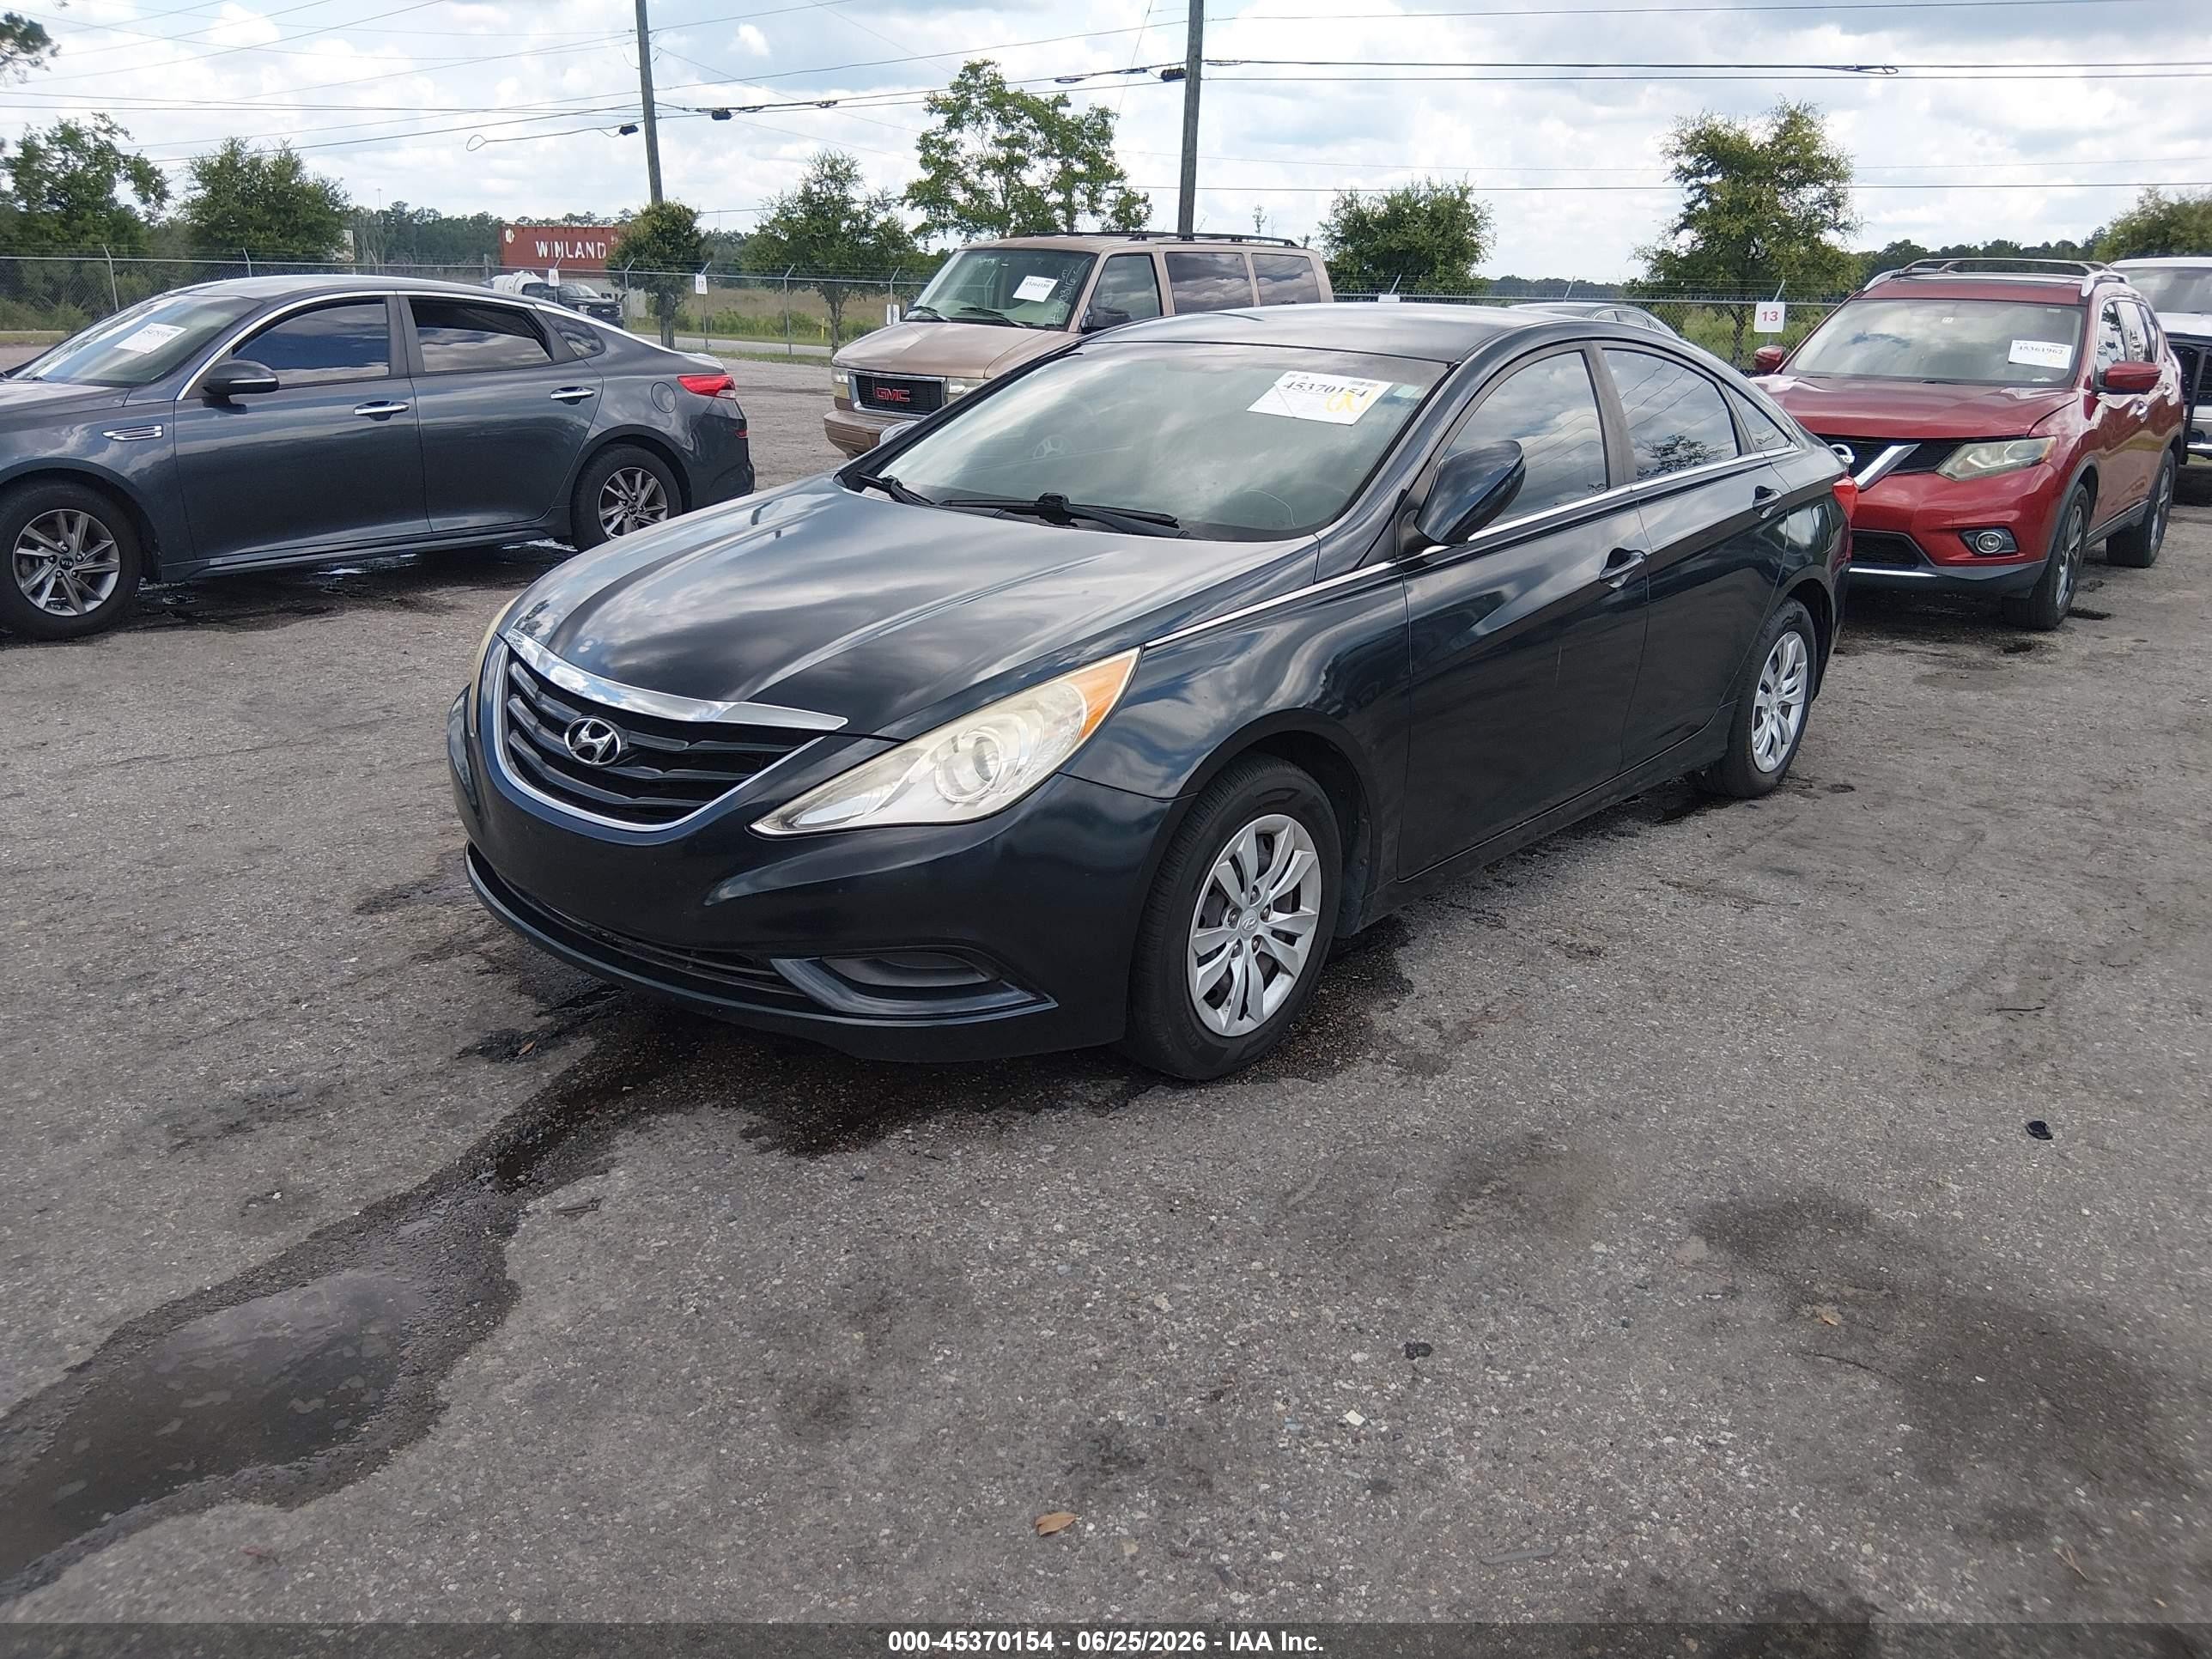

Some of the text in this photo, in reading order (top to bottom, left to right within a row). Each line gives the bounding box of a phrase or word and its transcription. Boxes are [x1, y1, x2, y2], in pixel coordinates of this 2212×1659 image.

[536, 240, 606, 259] WINLAND
[1762, 311, 1778, 322] 13
[875, 386, 910, 403] GMC
